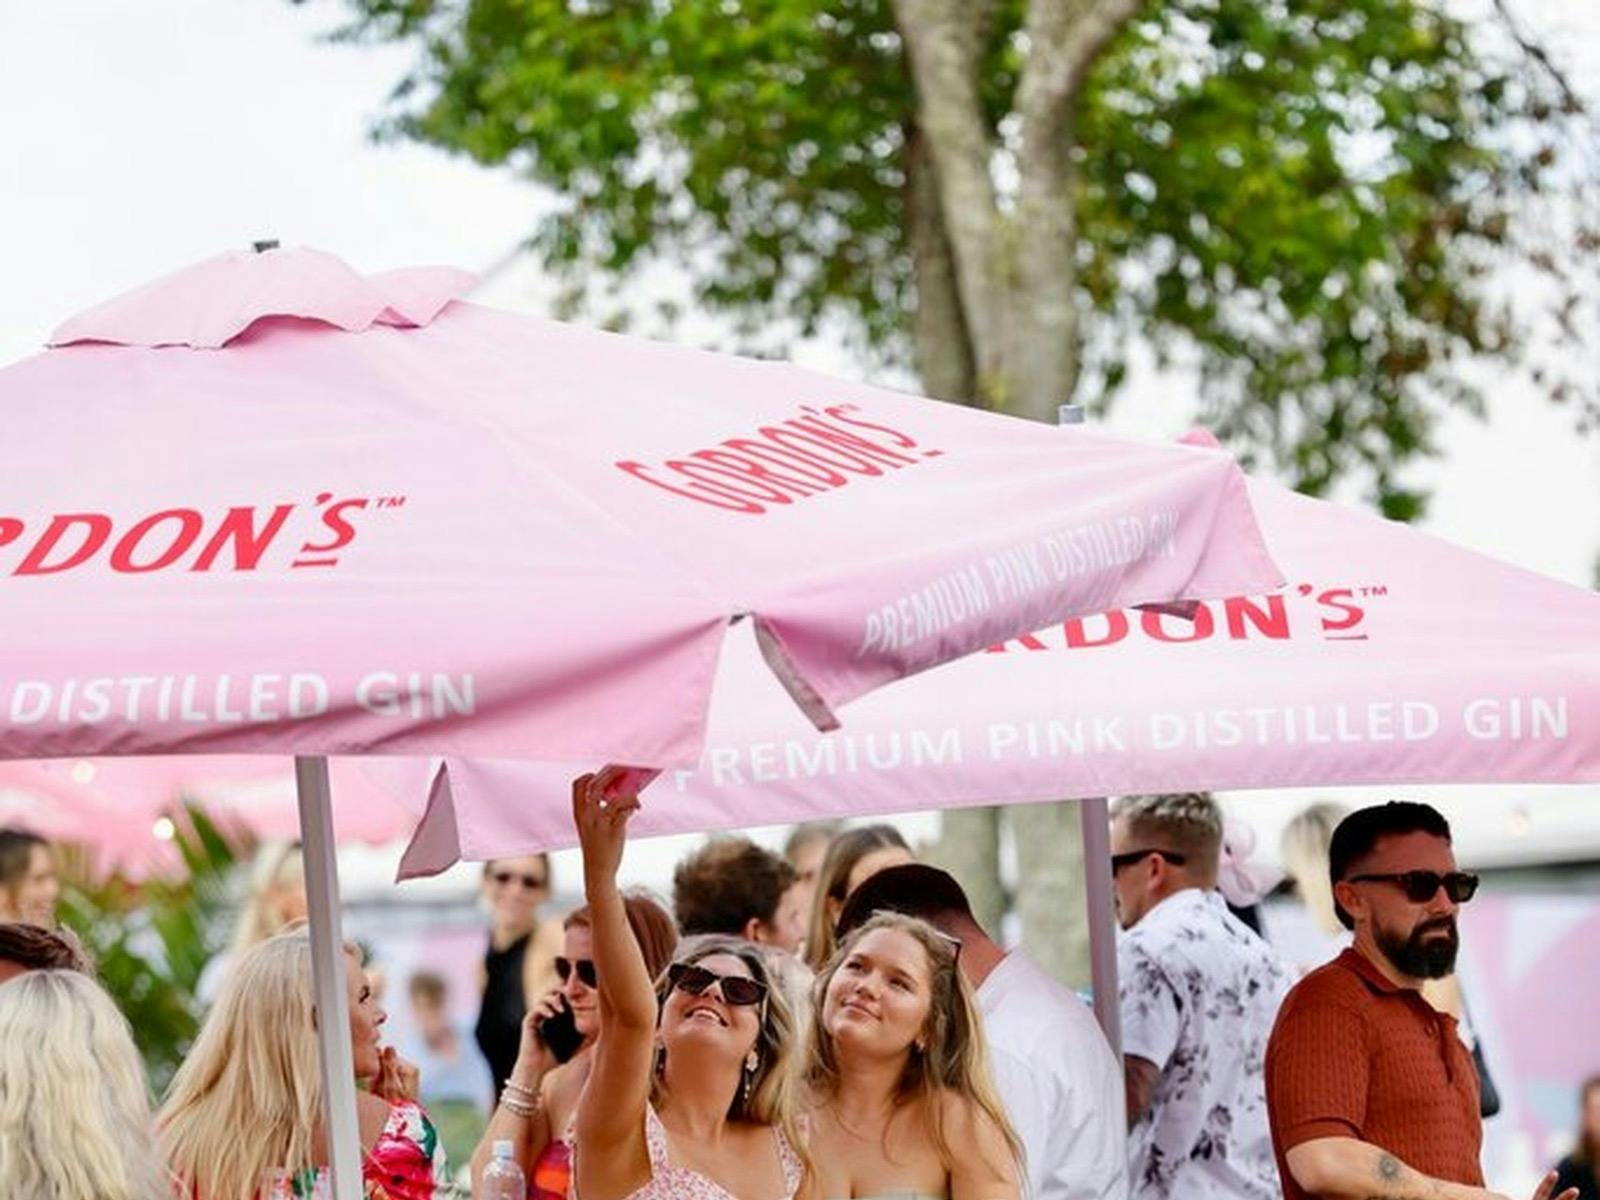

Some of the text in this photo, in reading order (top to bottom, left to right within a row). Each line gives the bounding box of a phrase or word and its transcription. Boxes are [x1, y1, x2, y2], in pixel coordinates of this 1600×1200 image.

[613, 403, 920, 514] GORDON'S
[860, 564, 990, 656] PREMIUM
[987, 543, 1049, 602] PINK
[1044, 513, 1144, 583] DISTILLED
[985, 584, 1368, 653] DON'S
[10, 672, 477, 724] DISTILLED GIN
[988, 715, 1126, 760] PINK
[1150, 701, 1440, 751] DISTILLED
[1463, 696, 1569, 740] GIN
